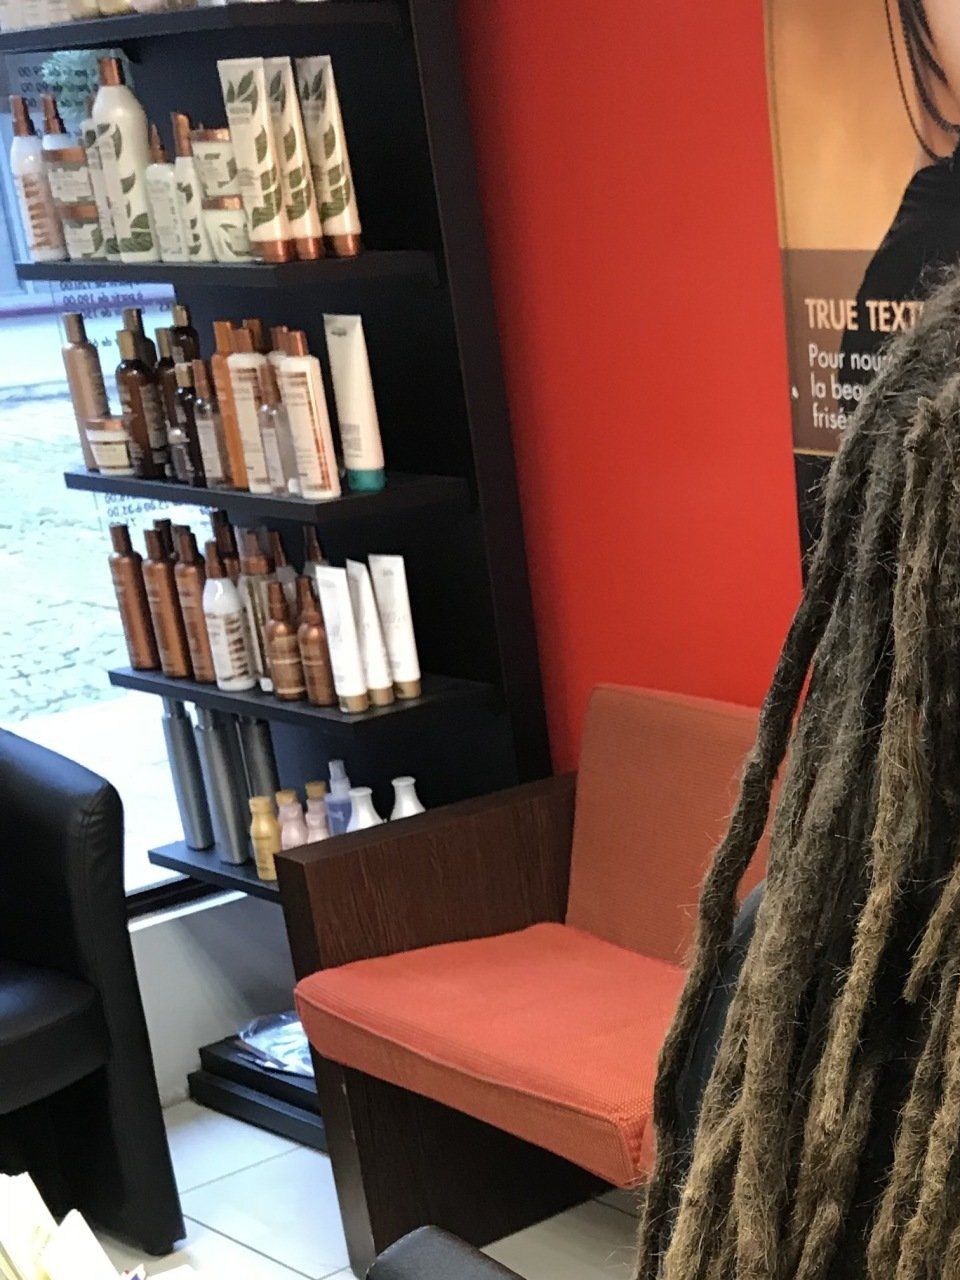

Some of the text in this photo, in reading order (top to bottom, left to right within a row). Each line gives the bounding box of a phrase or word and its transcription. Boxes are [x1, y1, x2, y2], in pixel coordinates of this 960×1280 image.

[804, 298, 924, 332] TRUE TEXT
[809, 343, 846, 368] Pour
[811, 372, 827, 398] la
